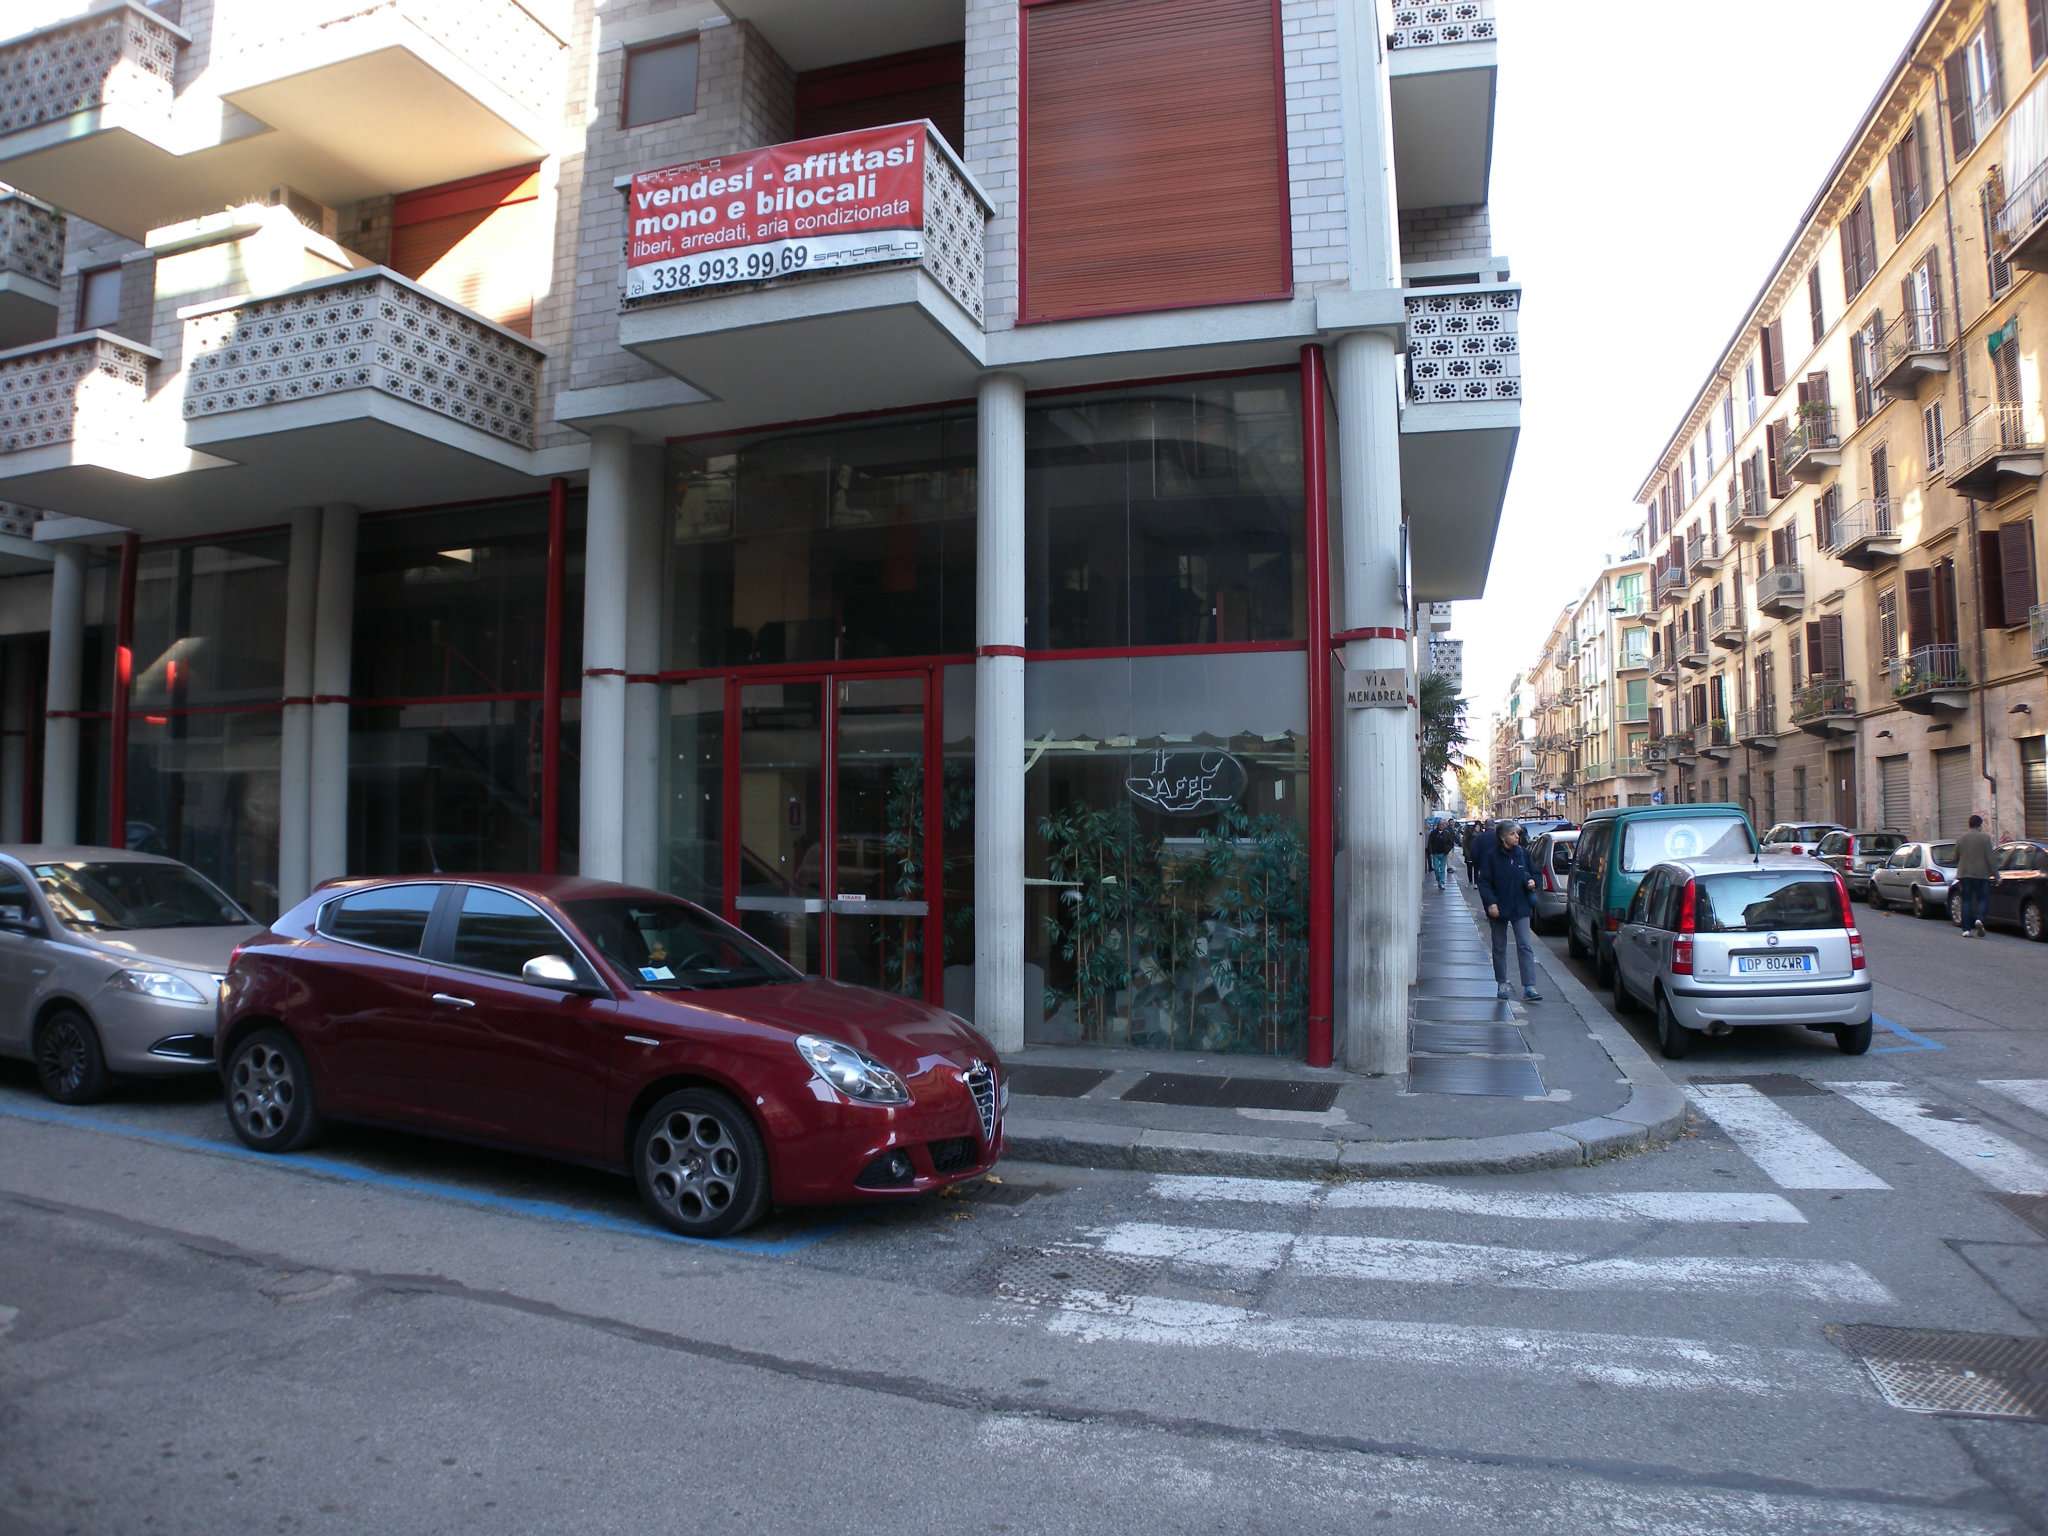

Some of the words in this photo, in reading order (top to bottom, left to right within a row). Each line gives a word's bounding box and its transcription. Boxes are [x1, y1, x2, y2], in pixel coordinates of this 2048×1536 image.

[637, 166, 753, 209] vendesi
[784, 138, 915, 183] affittasi
[635, 206, 717, 236] mono
[727, 200, 745, 219] e
[757, 173, 876, 215] bilocali
[633, 236, 675, 257] liberi,
[681, 223, 750, 249] arredati,
[757, 217, 788, 237] aria
[795, 199, 910, 230] condizionata
[813, 242, 919, 261] SANCARLO
[652, 245, 808, 291] 338.993.99.69
[1348, 689, 1403, 702] MENABREA
[1365, 676, 1386, 686] VIA
[1747, 958, 1761, 970] DP
[1766, 957, 1802, 970] 804WR
